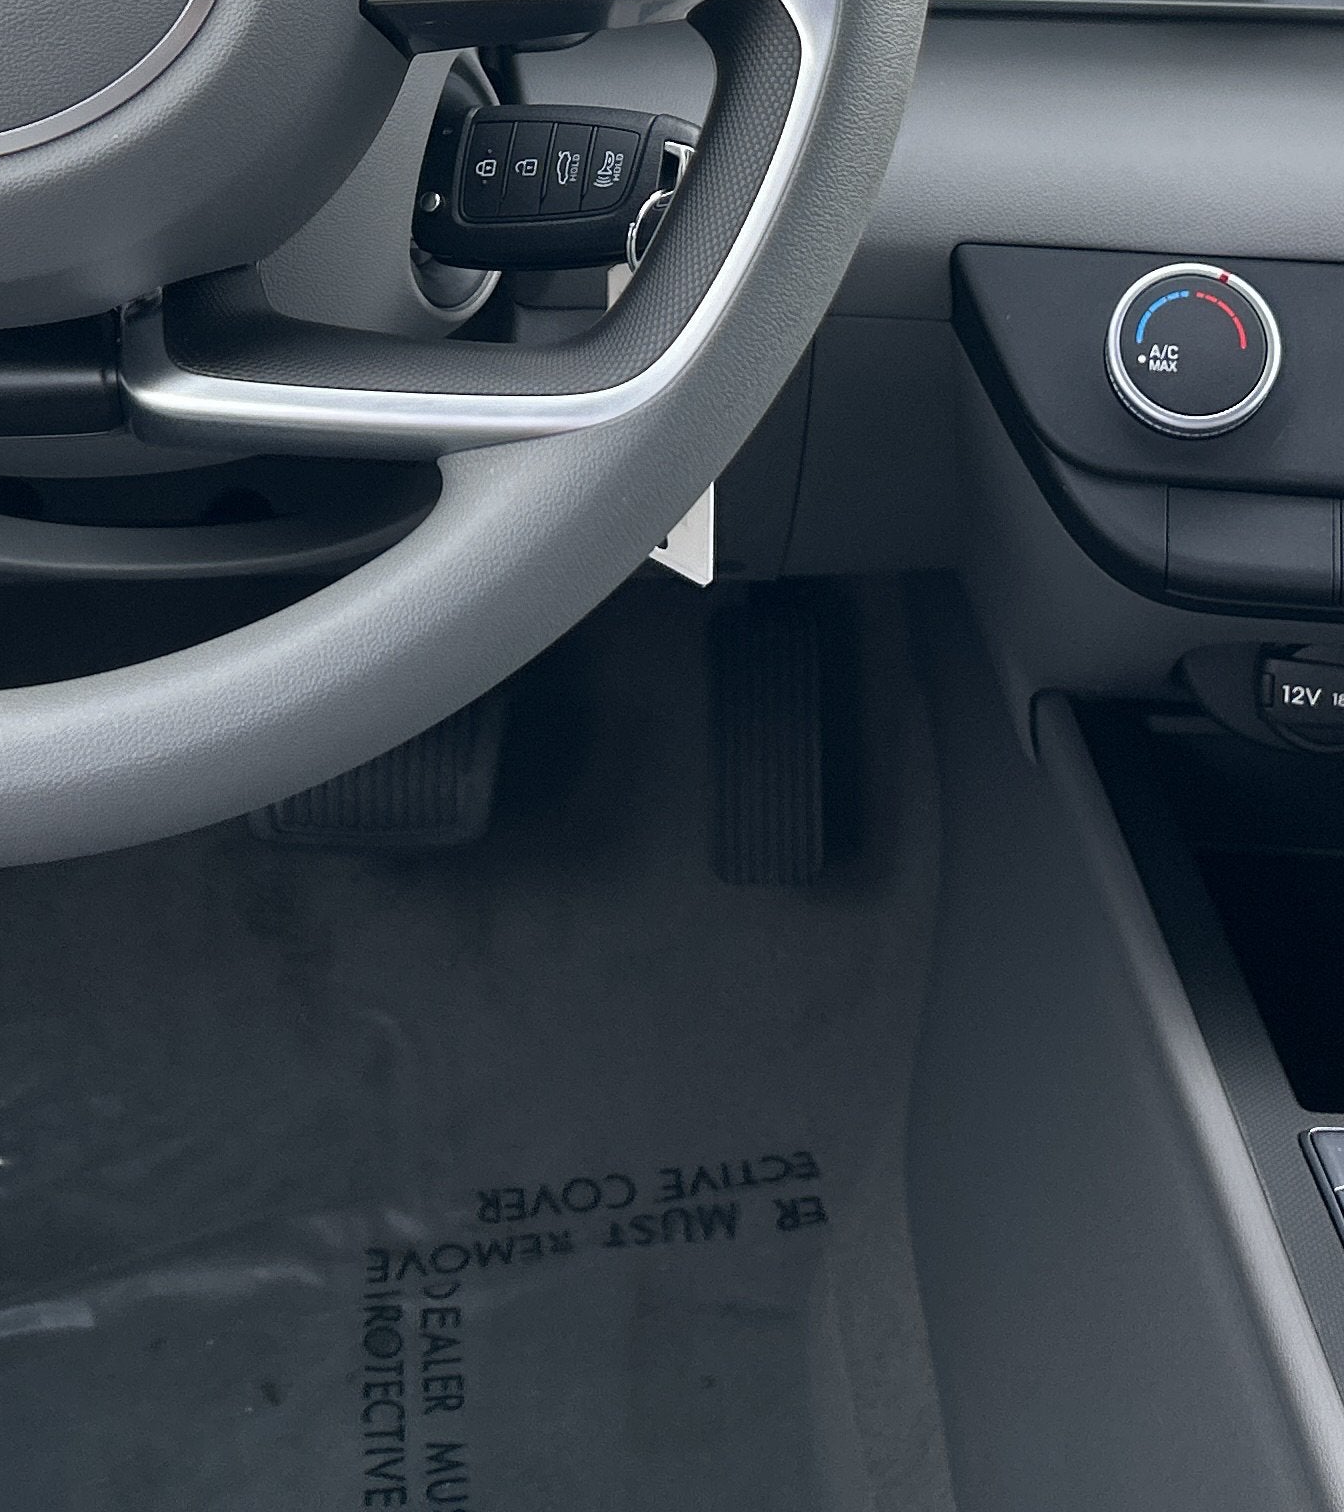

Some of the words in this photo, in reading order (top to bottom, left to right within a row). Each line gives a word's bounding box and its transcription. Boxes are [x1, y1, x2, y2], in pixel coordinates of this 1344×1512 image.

[568, 152, 581, 183] HOLD
[612, 152, 625, 183] HOLD
[1149, 343, 1179, 360] A/C
[1149, 359, 1178, 373] MAX
[1281, 684, 1322, 707] 12V
[475, 1171, 638, 1226] COVER
[604, 1201, 737, 1251] MUST
[366, 1228, 576, 1286] REMOVE
